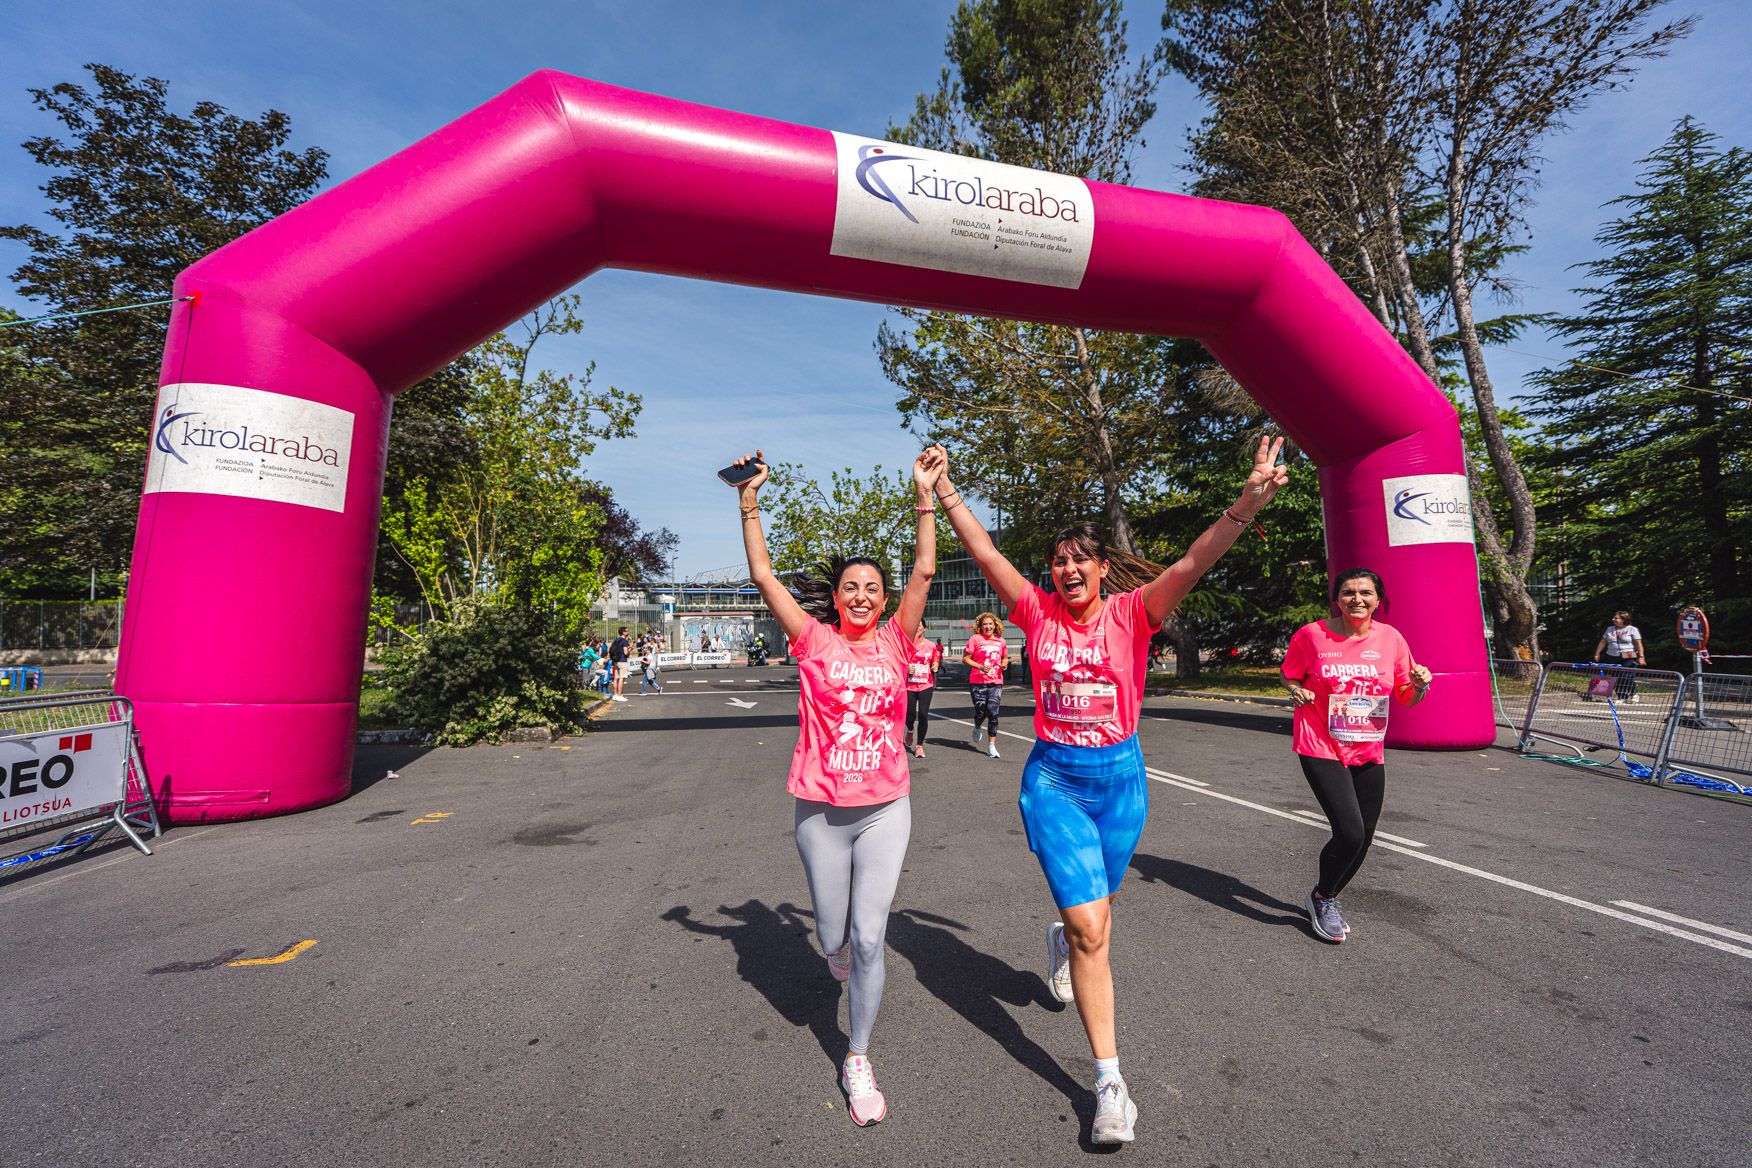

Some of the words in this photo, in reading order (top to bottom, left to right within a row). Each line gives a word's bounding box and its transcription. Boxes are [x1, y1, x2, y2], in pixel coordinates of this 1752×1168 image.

[907, 164, 1079, 223] kirolaraba
[952, 218, 991, 230] FUNDAZIOA
[997, 226, 1024, 236] Arabako
[1024, 229, 1039, 238] Foru
[951, 228, 990, 240] FUNDACIÓN
[995, 236, 1029, 247] Diputación
[1030, 240, 1046, 249] Foral
[1046, 243, 1055, 251] de
[181, 421, 340, 468] kirolaraba
[215, 465, 254, 474] FUNDACIÓN
[216, 458, 254, 467] FUNDAZIOA
[260, 463, 288, 472] Arabako
[288, 467, 303, 475] Foru
[1318, 651, 1343, 659] OYSHO
[1321, 663, 1380, 679] CARRERA
[1062, 695, 1091, 708] 016
[1347, 716, 1370, 724] 016
[856, 726, 873, 750] LA
[829, 748, 882, 771] MUJER
[0, 754, 75, 799] EO
